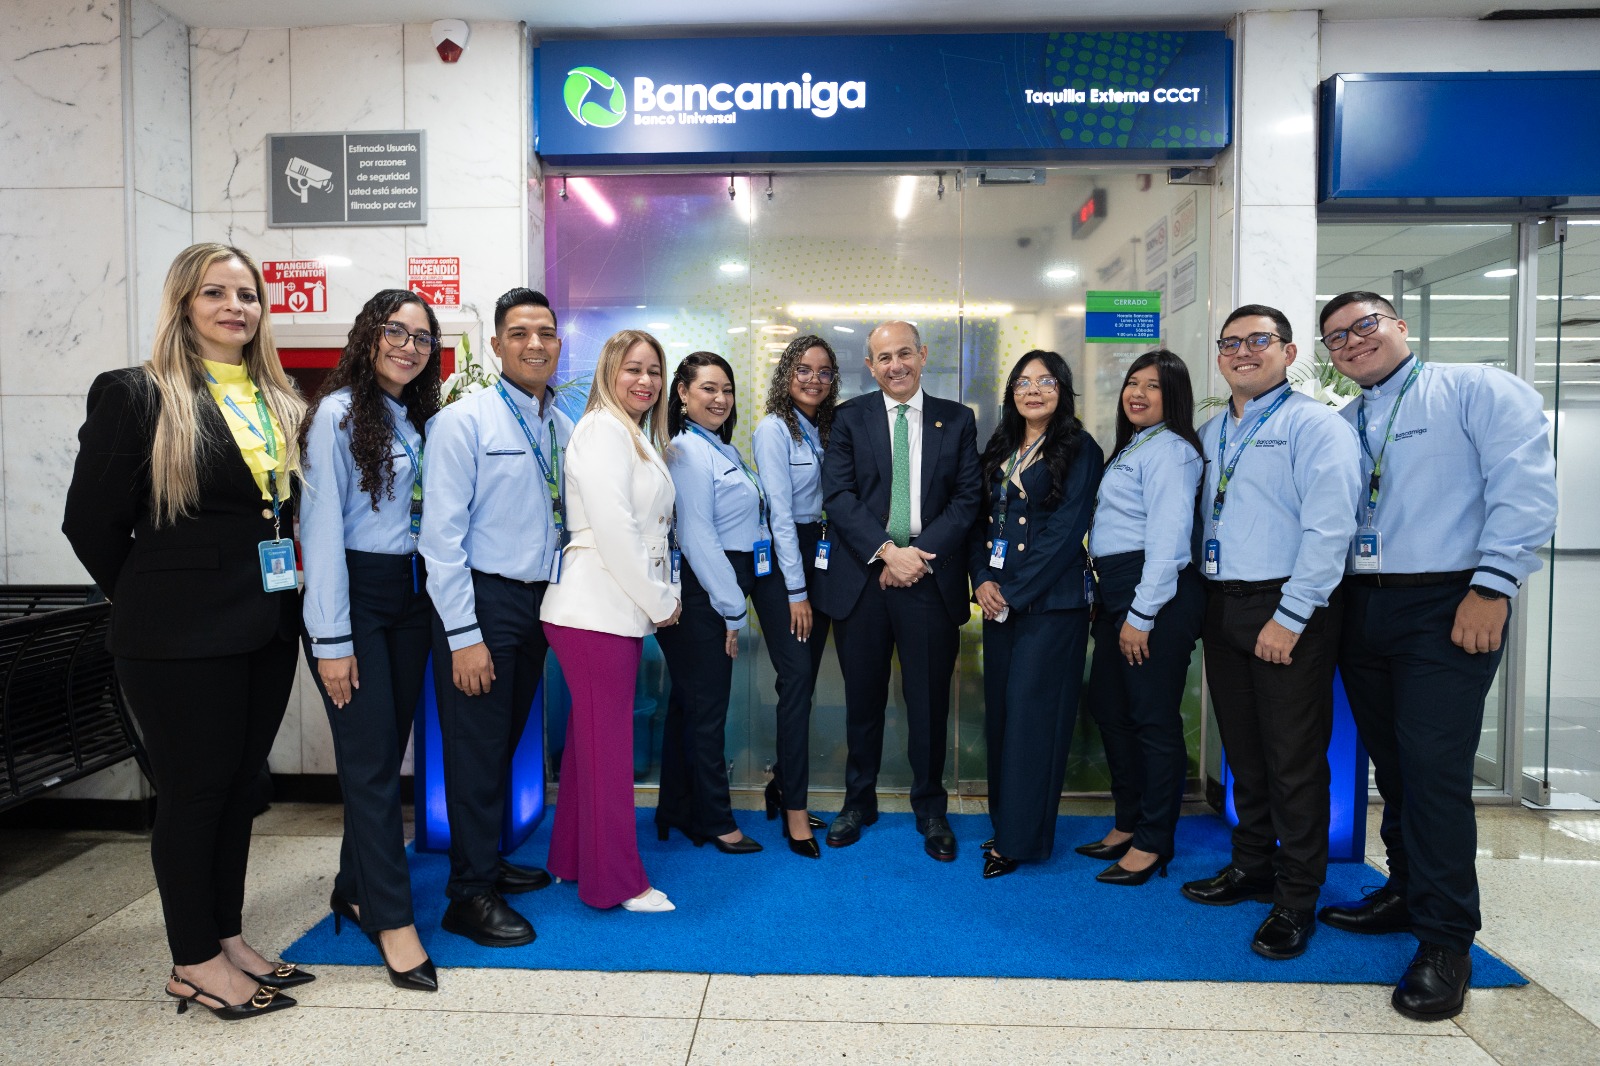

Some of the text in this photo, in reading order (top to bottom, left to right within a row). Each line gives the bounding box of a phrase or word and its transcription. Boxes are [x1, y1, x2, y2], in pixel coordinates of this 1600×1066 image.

[633, 72, 867, 118] Bancamiga
[1024, 88, 1086, 106] Taquilla
[1090, 88, 1150, 103] Externa
[1153, 87, 1201, 103] CCCT
[634, 111, 737, 126] Banco Universal
[349, 144, 417, 153] Estimado Usuario,
[360, 160, 373, 168] por
[370, 172, 410, 182] seguridad
[349, 186, 418, 195] usted está siendo
[351, 200, 416, 210] filmado por cctv
[276, 262, 324, 270] MANGUERA
[410, 264, 458, 275] INCENDIO
[276, 270, 325, 280] y EXTINTOR
[1396, 428, 1428, 438] Bancamiga
